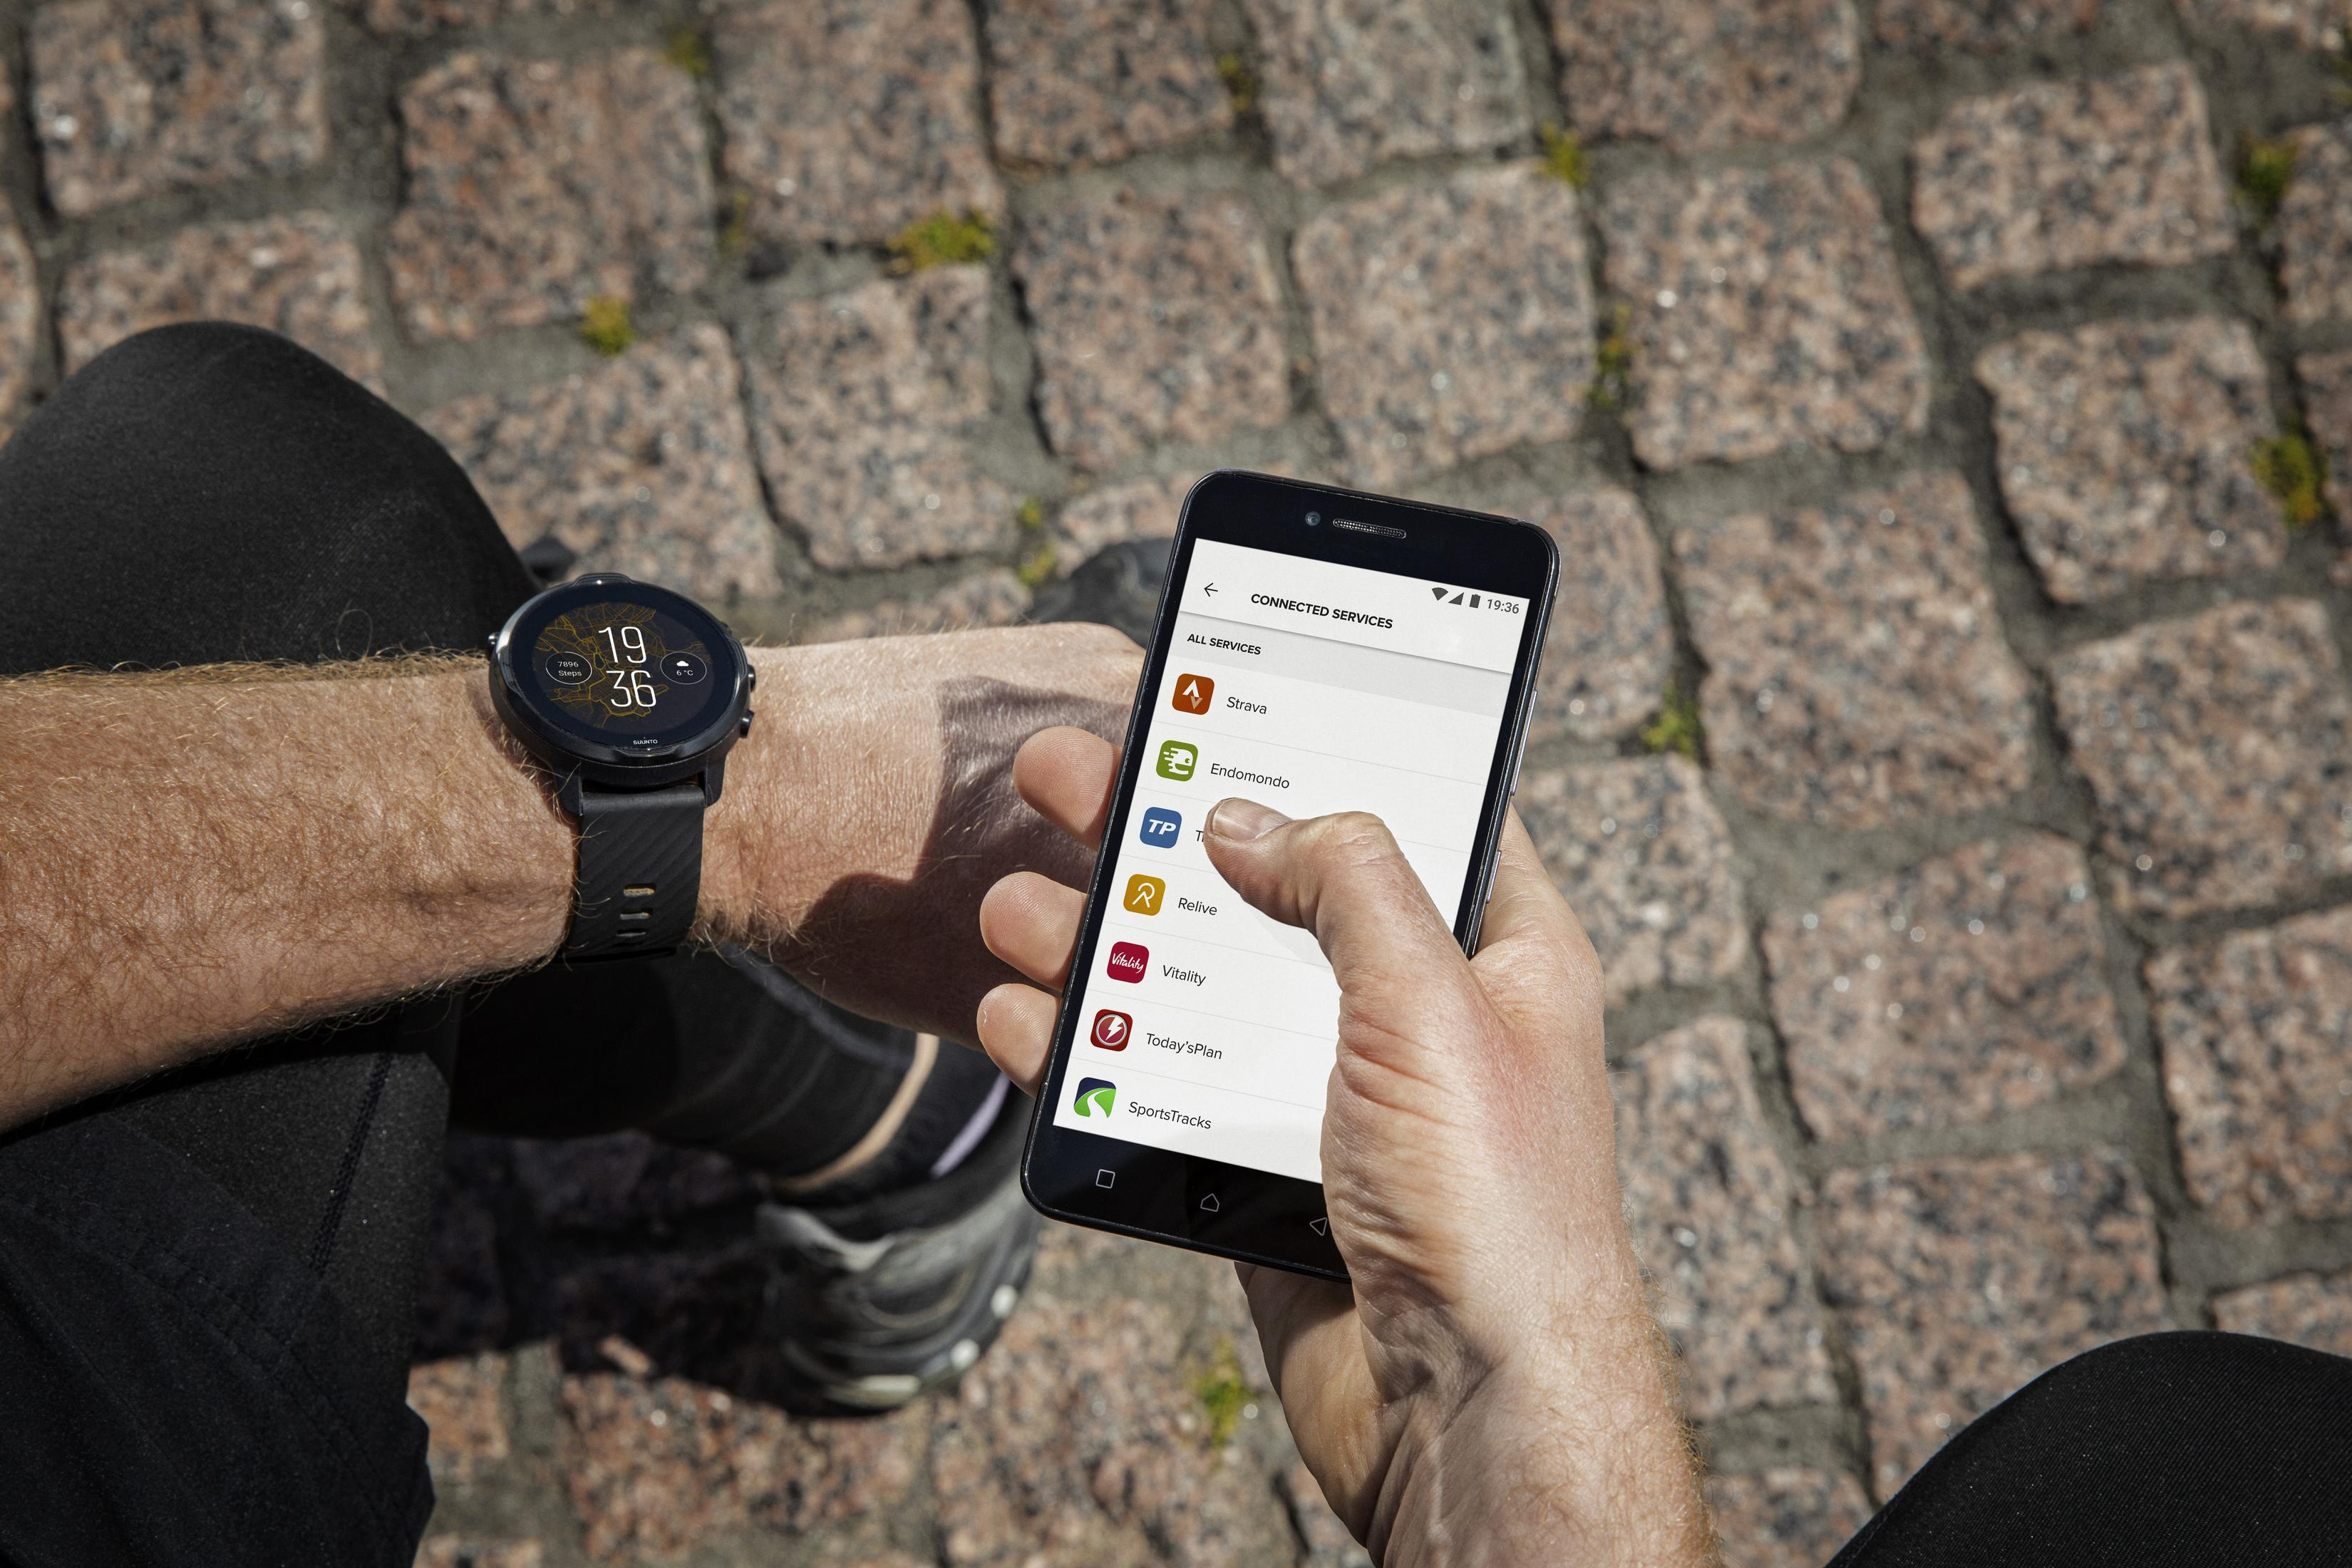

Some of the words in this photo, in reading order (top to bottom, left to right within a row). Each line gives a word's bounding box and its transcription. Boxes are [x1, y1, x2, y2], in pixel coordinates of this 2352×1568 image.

[1251, 593, 1330, 617] CONNECTED
[1331, 609, 1393, 629] SERVICES
[1487, 598, 1520, 614] 19:36
[598, 626, 647, 664] 19
[1187, 634, 1207, 645] ALL
[1209, 637, 1262, 655] SERVICES
[606, 670, 656, 708] 36
[1227, 696, 1267, 715] Strava
[1210, 763, 1290, 789] Endomondo
[1148, 818, 1177, 836] TP
[1177, 897, 1217, 916] Relive
[1112, 951, 1144, 974] Vitality
[1162, 964, 1207, 987] Vitality
[1128, 1101, 1212, 1130] SportsTracks
